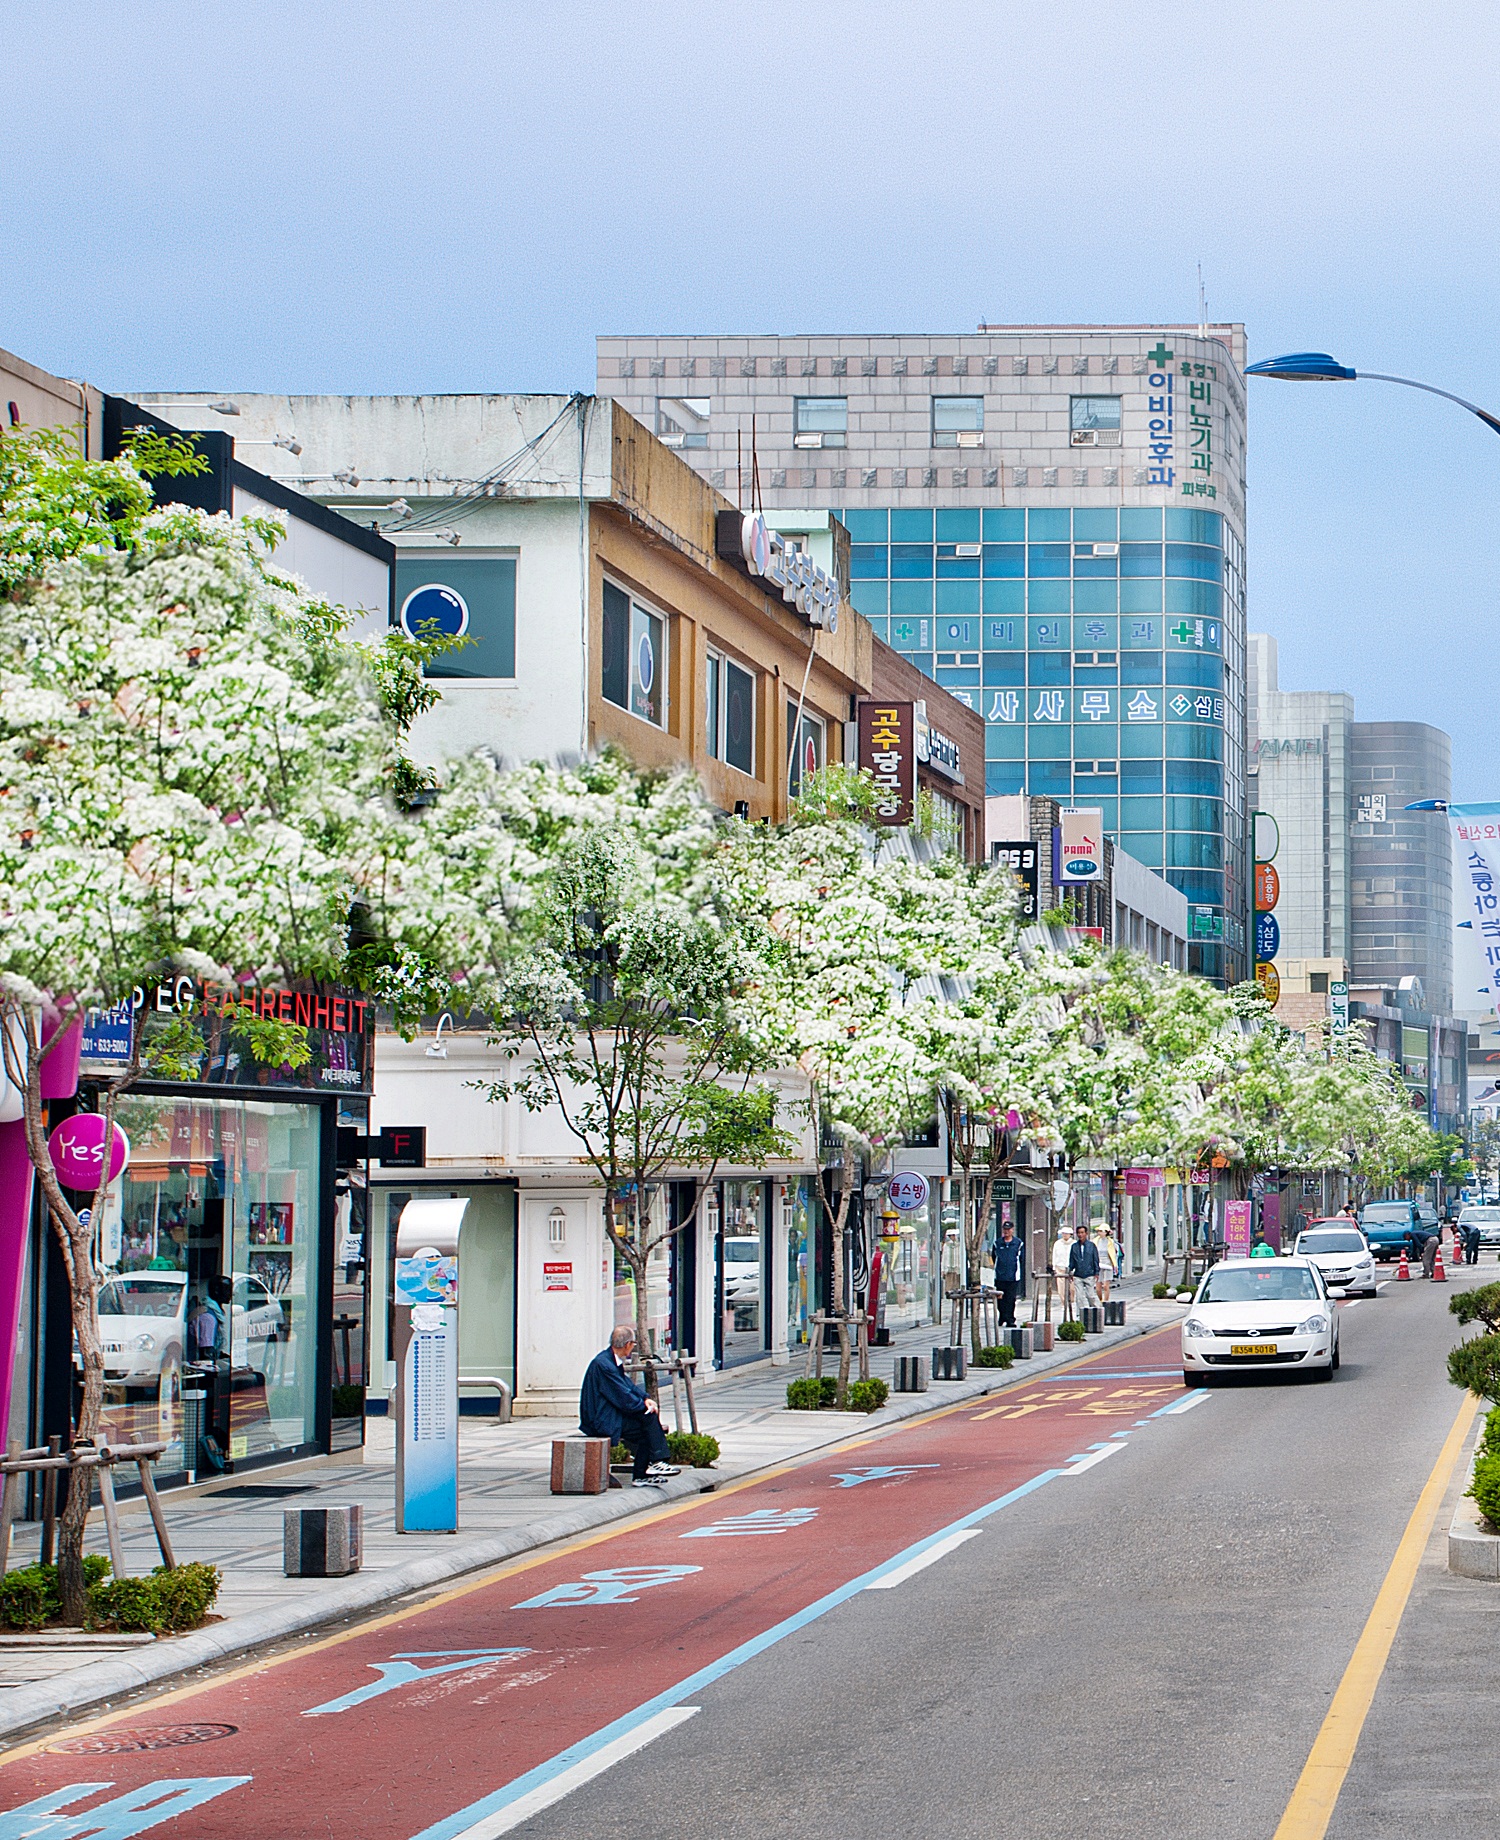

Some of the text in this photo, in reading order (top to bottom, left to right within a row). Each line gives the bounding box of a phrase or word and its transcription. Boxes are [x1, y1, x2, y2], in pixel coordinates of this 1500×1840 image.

[1147, 373, 1175, 487] 이비인후과
[1189, 380, 1213, 476] 비뇨기과
[947, 621, 1154, 645] 이비인후과
[1359, 795, 1385, 808] 내외
[1359, 809, 1384, 821] 건축
[1064, 845, 1092, 855] PAMA
[1264, 926, 1275, 952] 삼도
[202, 980, 368, 1034] FAHRENHEIT
[58, 1133, 106, 1163] Yes
[890, 1182, 924, 1198] 플스방
[1229, 1225, 1246, 1233] 18K
[1229, 1233, 1246, 1241] 14K
